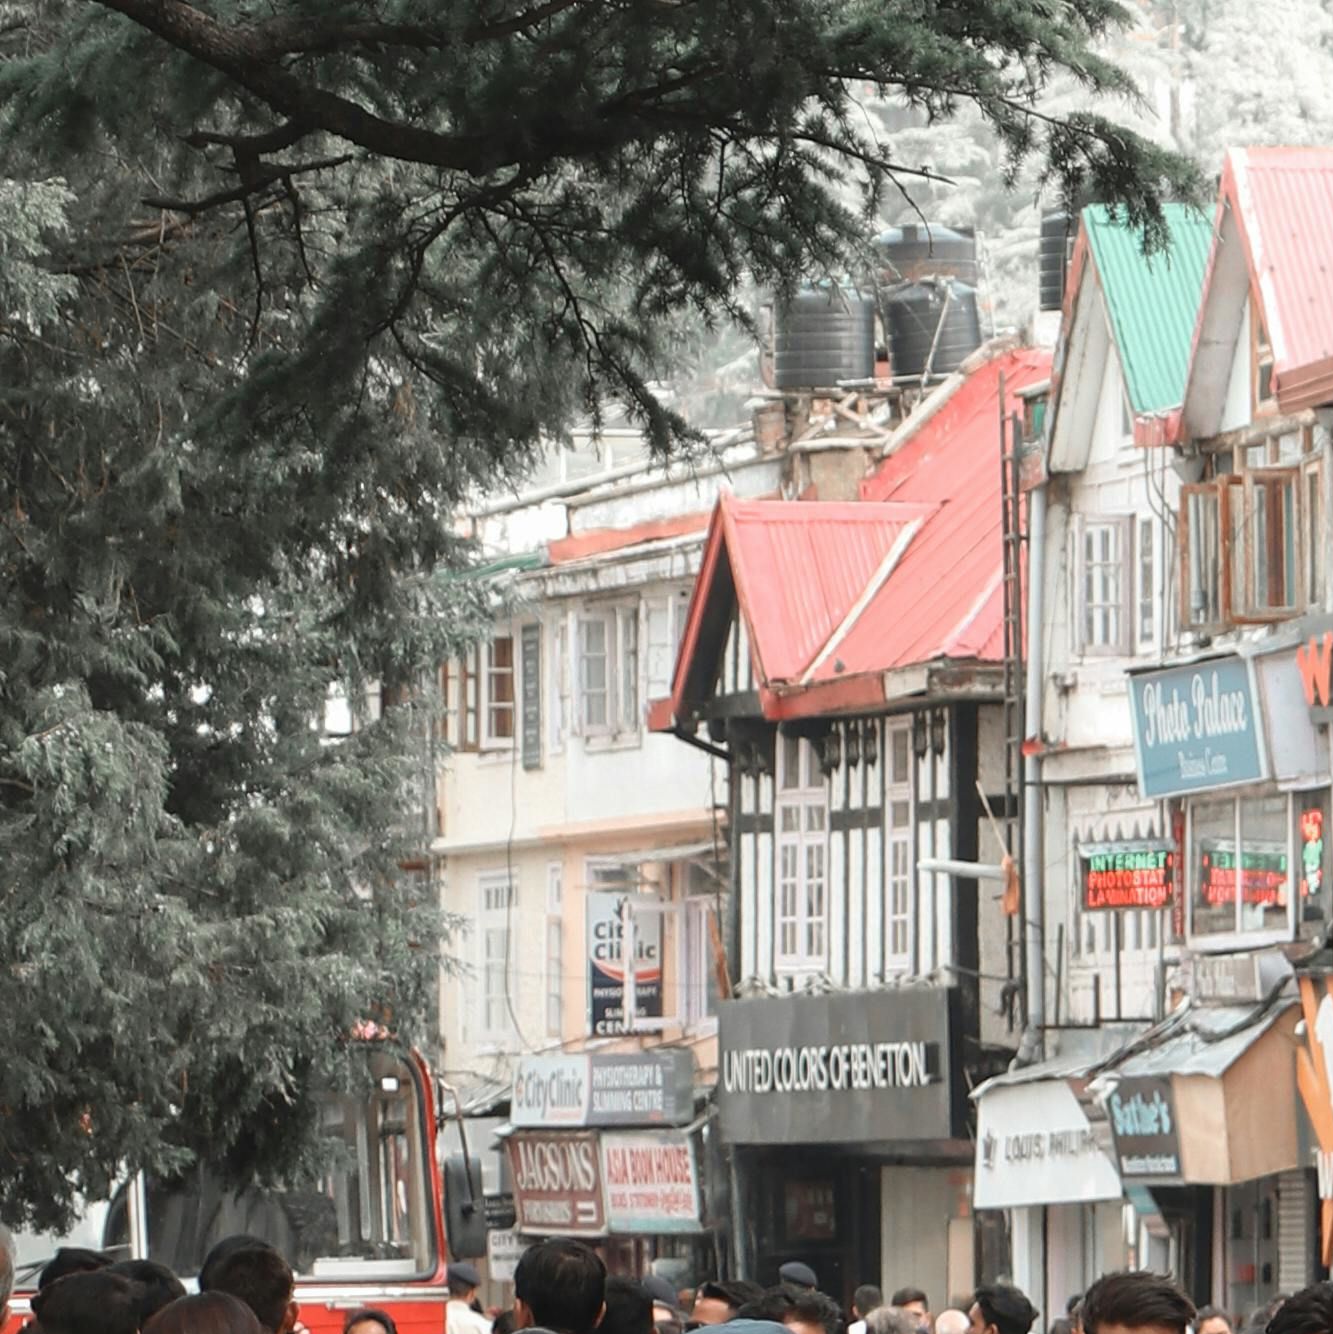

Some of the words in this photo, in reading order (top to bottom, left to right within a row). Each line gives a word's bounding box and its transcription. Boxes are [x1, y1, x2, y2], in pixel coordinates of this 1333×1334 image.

[1143, 681, 1191, 748] Photo
[1191, 670, 1247, 739] Palace
[1088, 868, 1166, 888] PHOTOSTAT
[1089, 851, 1167, 871] INTERNET
[594, 940, 657, 960] Cliic
[723, 1049, 772, 1094] UNITED
[773, 1046, 828, 1092] COLORS
[829, 1045, 850, 1090] OF
[517, 1140, 596, 1193] JAGSONS
